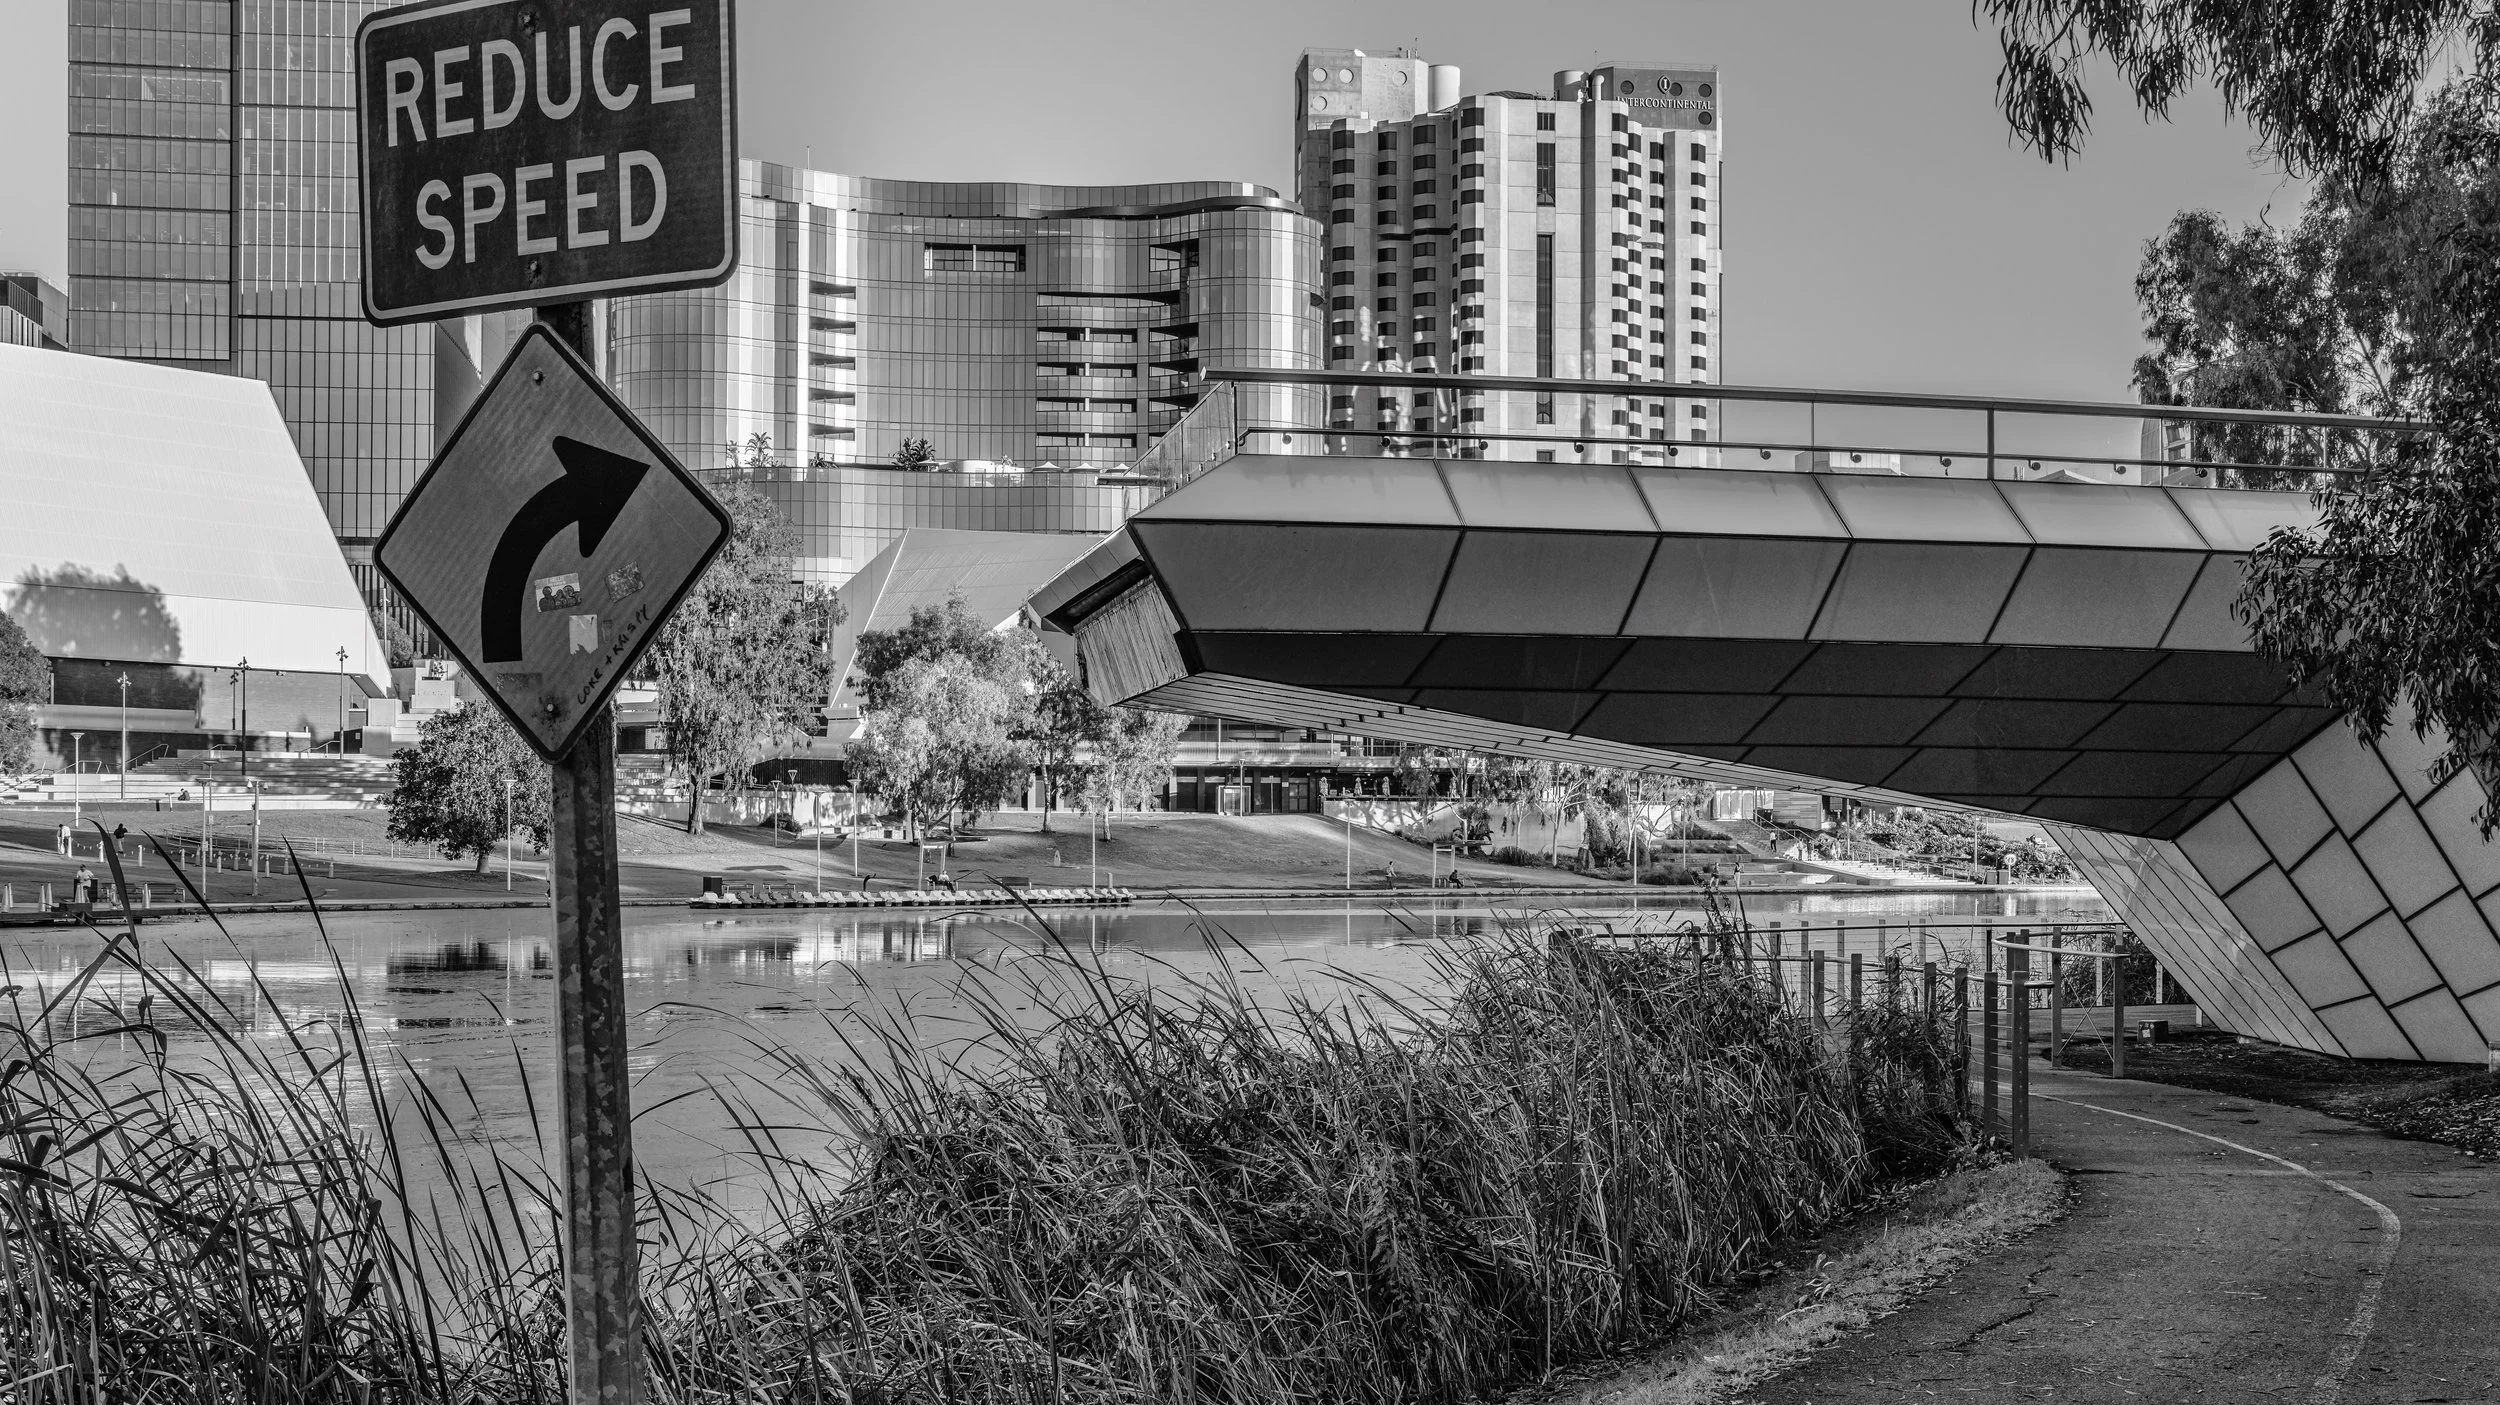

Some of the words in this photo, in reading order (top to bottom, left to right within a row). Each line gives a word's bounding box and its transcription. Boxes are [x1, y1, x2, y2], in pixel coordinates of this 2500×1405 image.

[386, 8, 695, 147] REDUCE
[415, 150, 667, 270] SPEED
[577, 667, 603, 704] COKE
